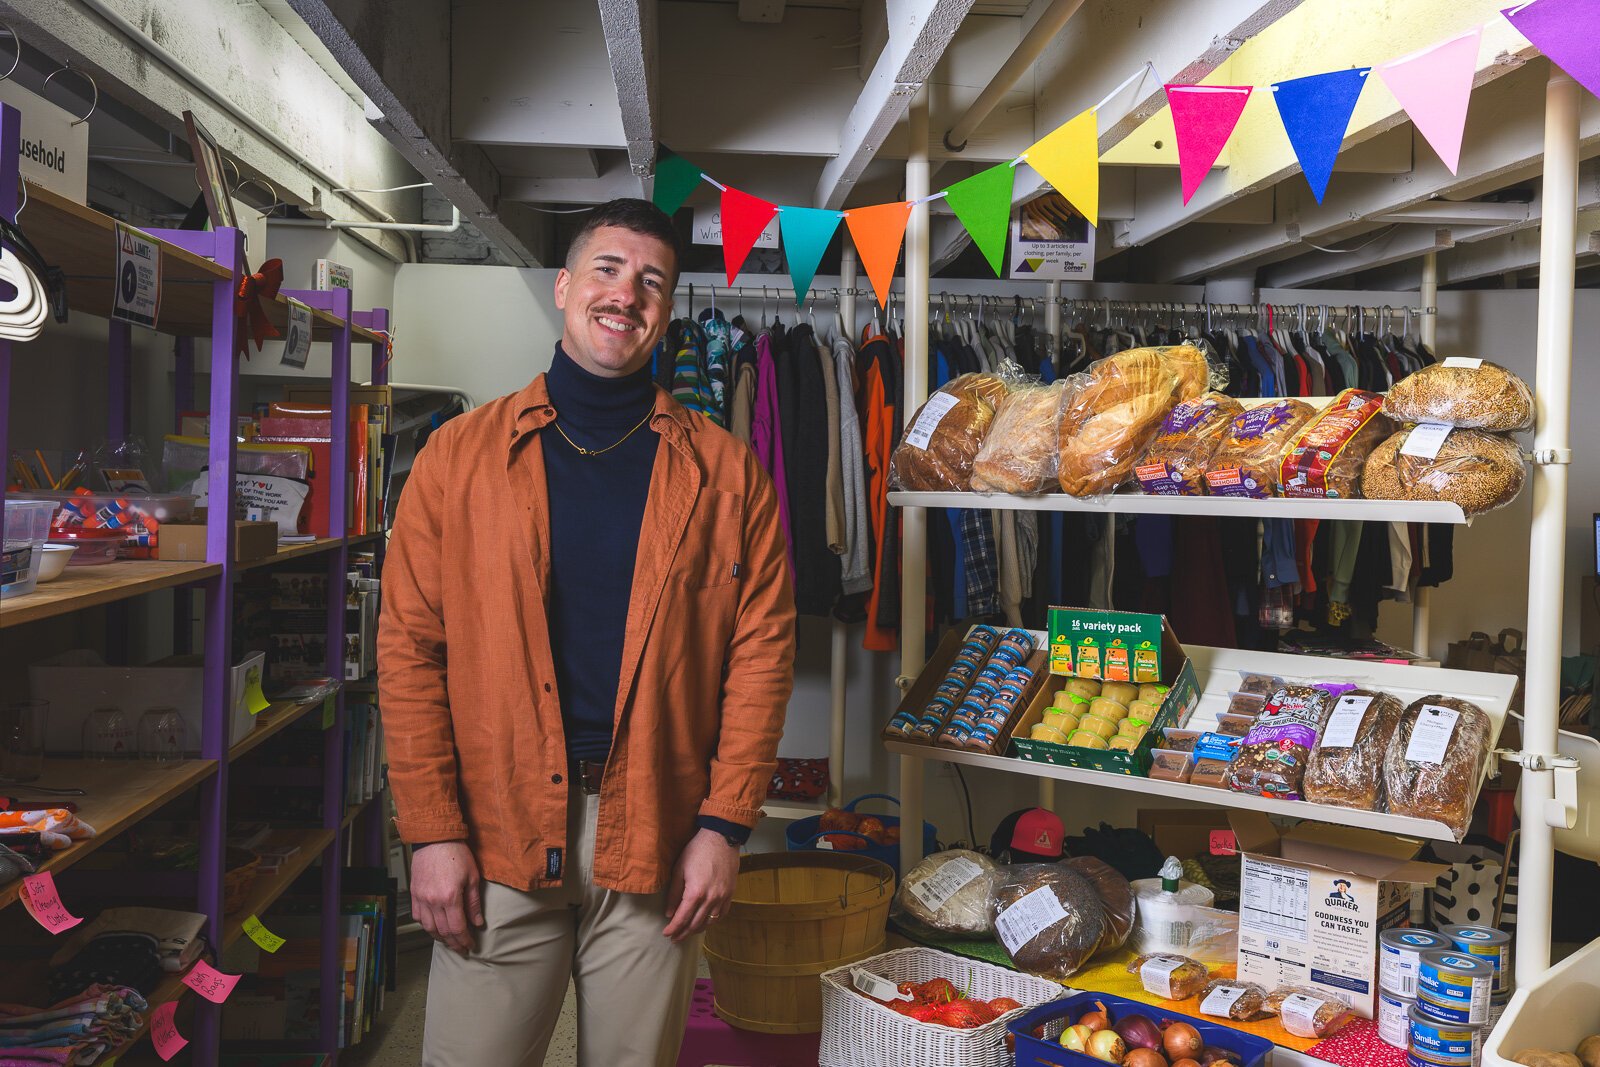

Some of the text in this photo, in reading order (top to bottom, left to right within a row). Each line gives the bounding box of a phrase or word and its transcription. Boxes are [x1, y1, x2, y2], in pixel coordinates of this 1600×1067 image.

[20, 139, 65, 174] usehold
[330, 276, 349, 288] WORDS
[1083, 621, 1116, 633] variety
[1118, 623, 1142, 633] pack
[1324, 898, 1359, 912] QUAKER
[1314, 911, 1369, 928] GOODNESS YOU
[1320, 920, 1362, 936] CAN TASTE.
[201, 977, 226, 996] Bags
[1419, 971, 1440, 988] Similac
[1414, 1030, 1441, 1047] Similac
